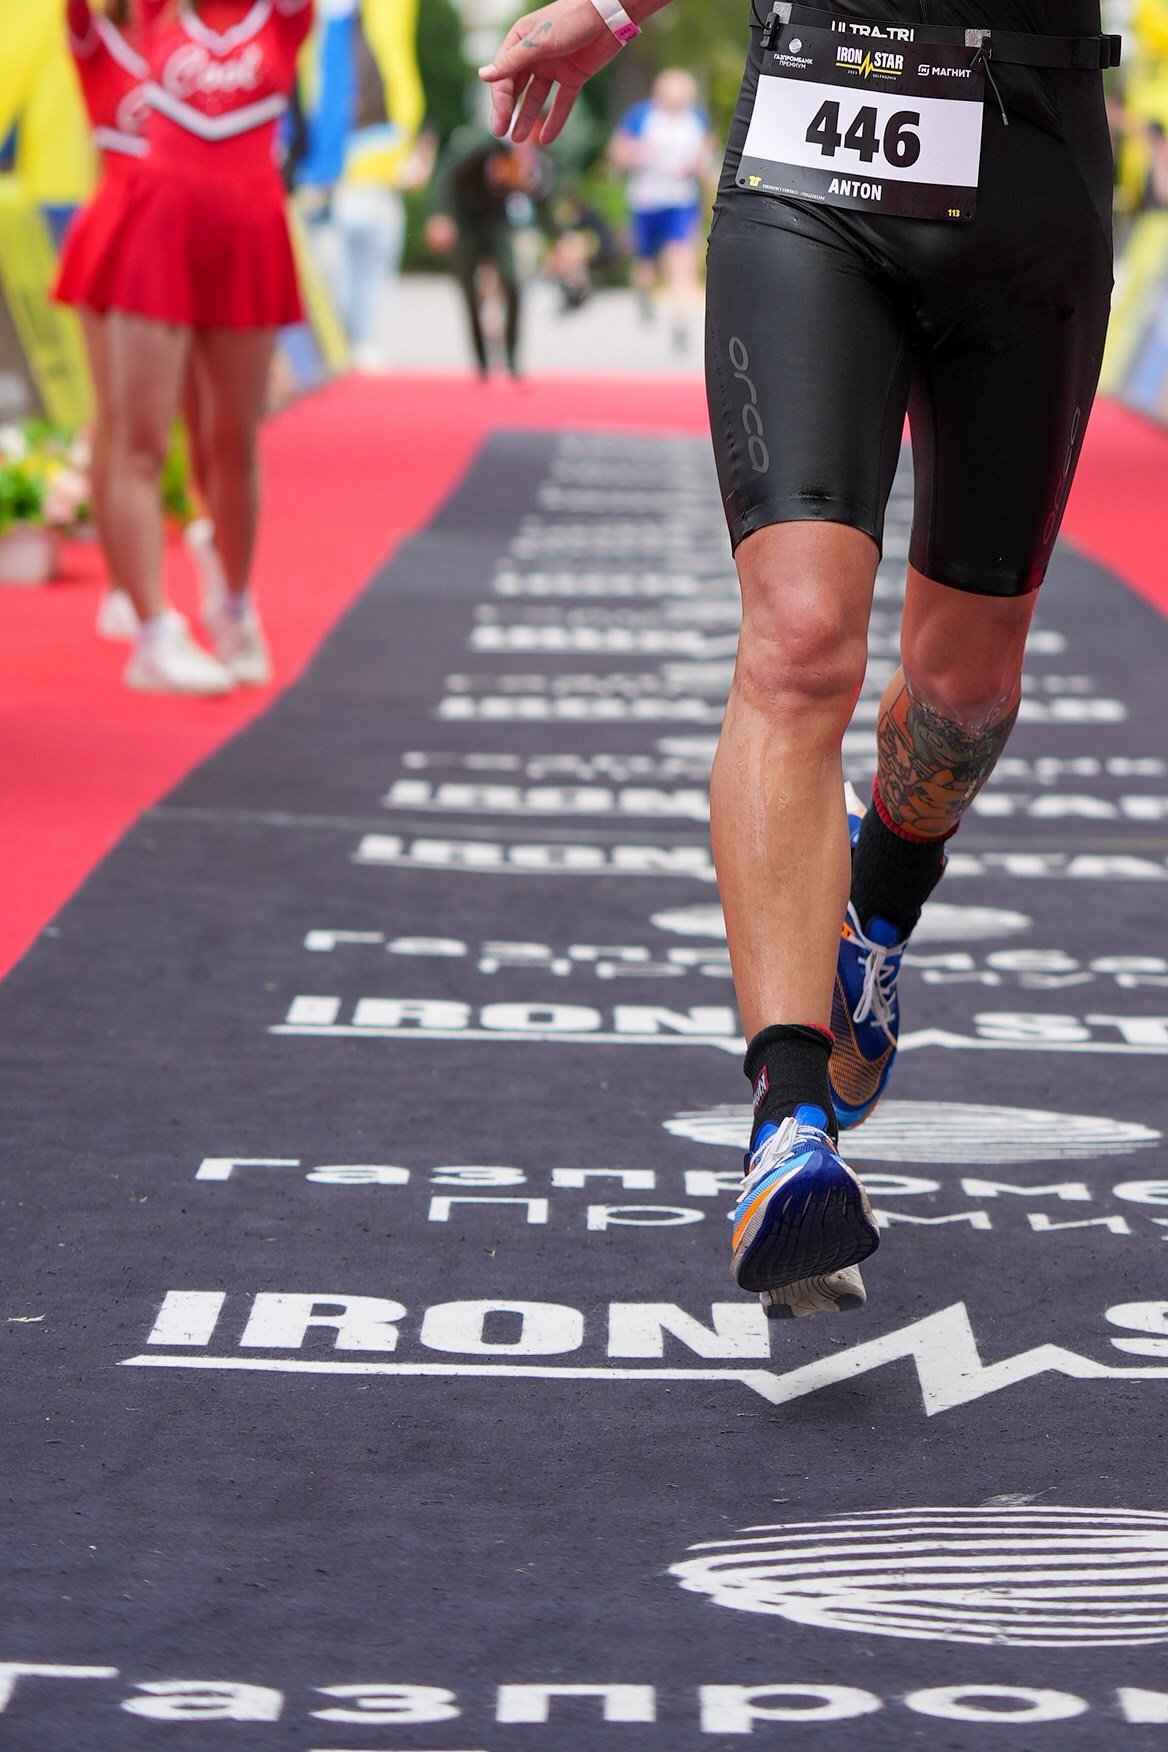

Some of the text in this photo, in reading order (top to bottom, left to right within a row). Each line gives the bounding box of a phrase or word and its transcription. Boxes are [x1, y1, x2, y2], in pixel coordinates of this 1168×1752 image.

[836, 45, 904, 70] IRON STAR
[931, 65, 972, 79] МАГНИТ
[805, 99, 922, 169] 446
[827, 177, 883, 202] ANTON
[947, 208, 961, 218] 113
[728, 335, 770, 474] orca
[286, 995, 737, 1034] IRON
[146, 1290, 772, 1359] IRON
